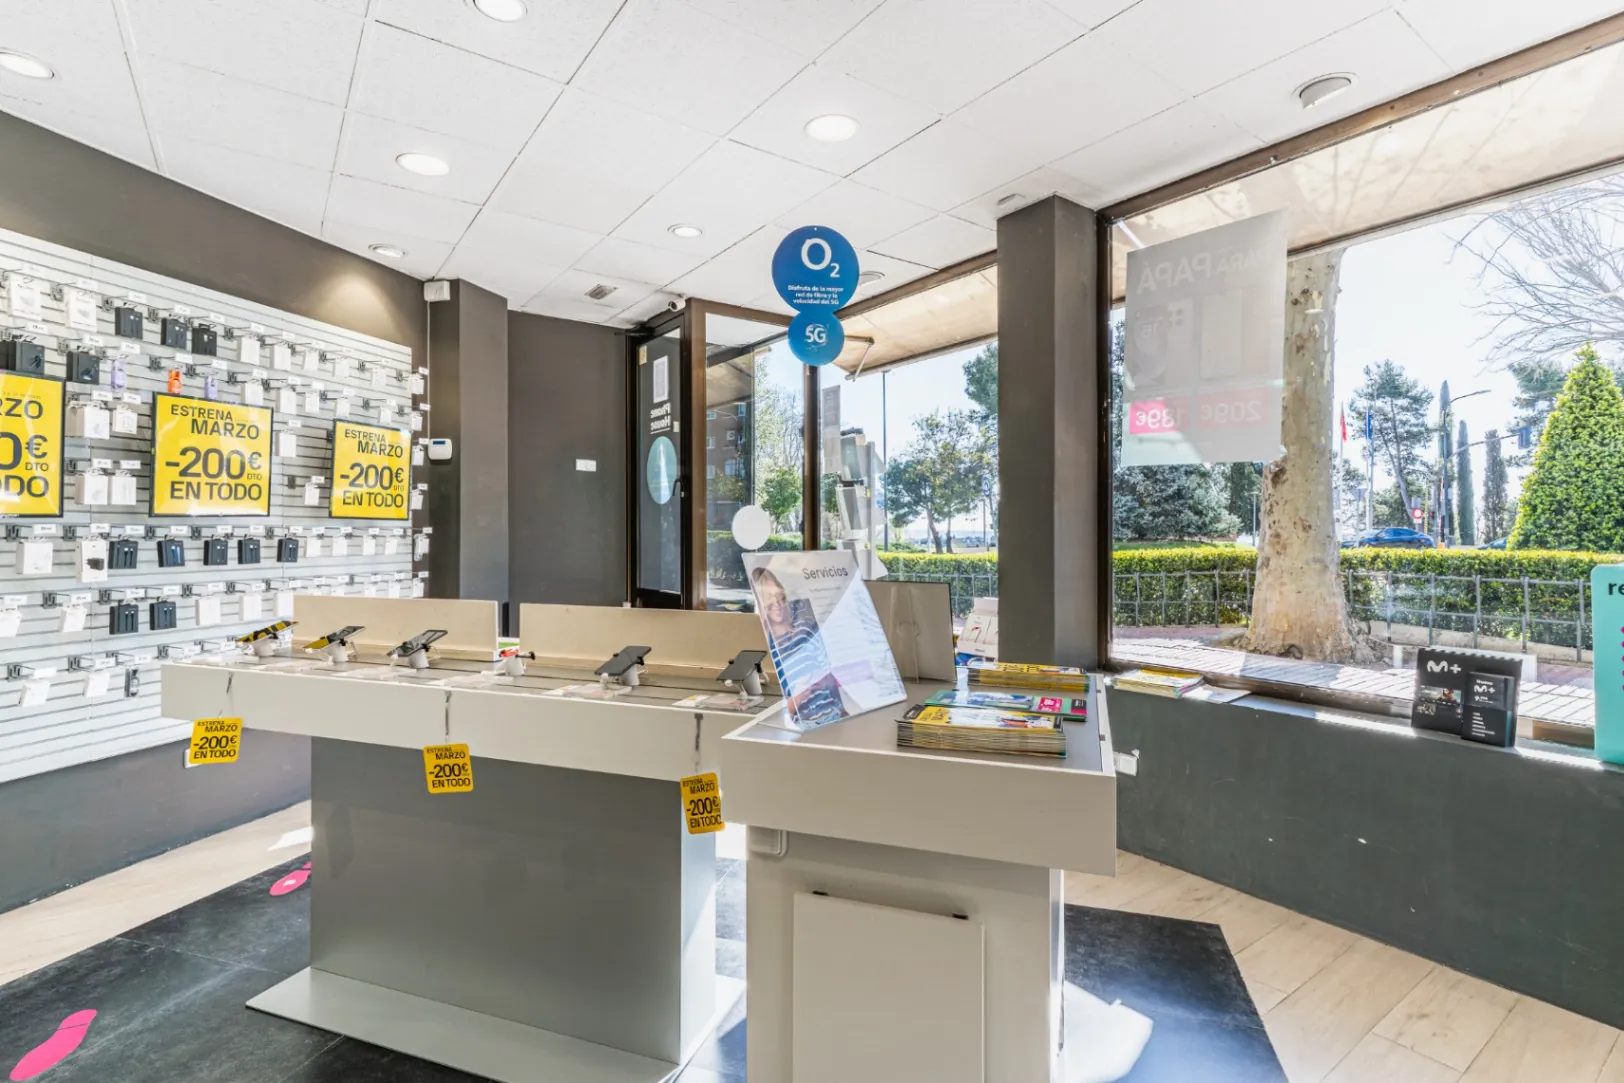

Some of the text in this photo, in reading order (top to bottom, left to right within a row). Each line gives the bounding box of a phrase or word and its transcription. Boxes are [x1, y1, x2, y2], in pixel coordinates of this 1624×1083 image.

[805, 327, 827, 343] 5G
[171, 404, 233, 421] ESTRENA
[191, 419, 260, 440] MARZO
[344, 428, 386, 443] ESTRENA
[357, 440, 403, 458] MARZO
[25, 462, 49, 471] DTO
[170, 481, 262, 501] EN TODO
[342, 490, 404, 508] EN TODO
[803, 565, 849, 580] Servicios
[193, 749, 236, 759] EN TODO
[435, 751, 466, 760] MARZO
[432, 778, 471, 788] EN TODO
[690, 782, 715, 794] MARZO
[700, 814, 722, 827] TODO
